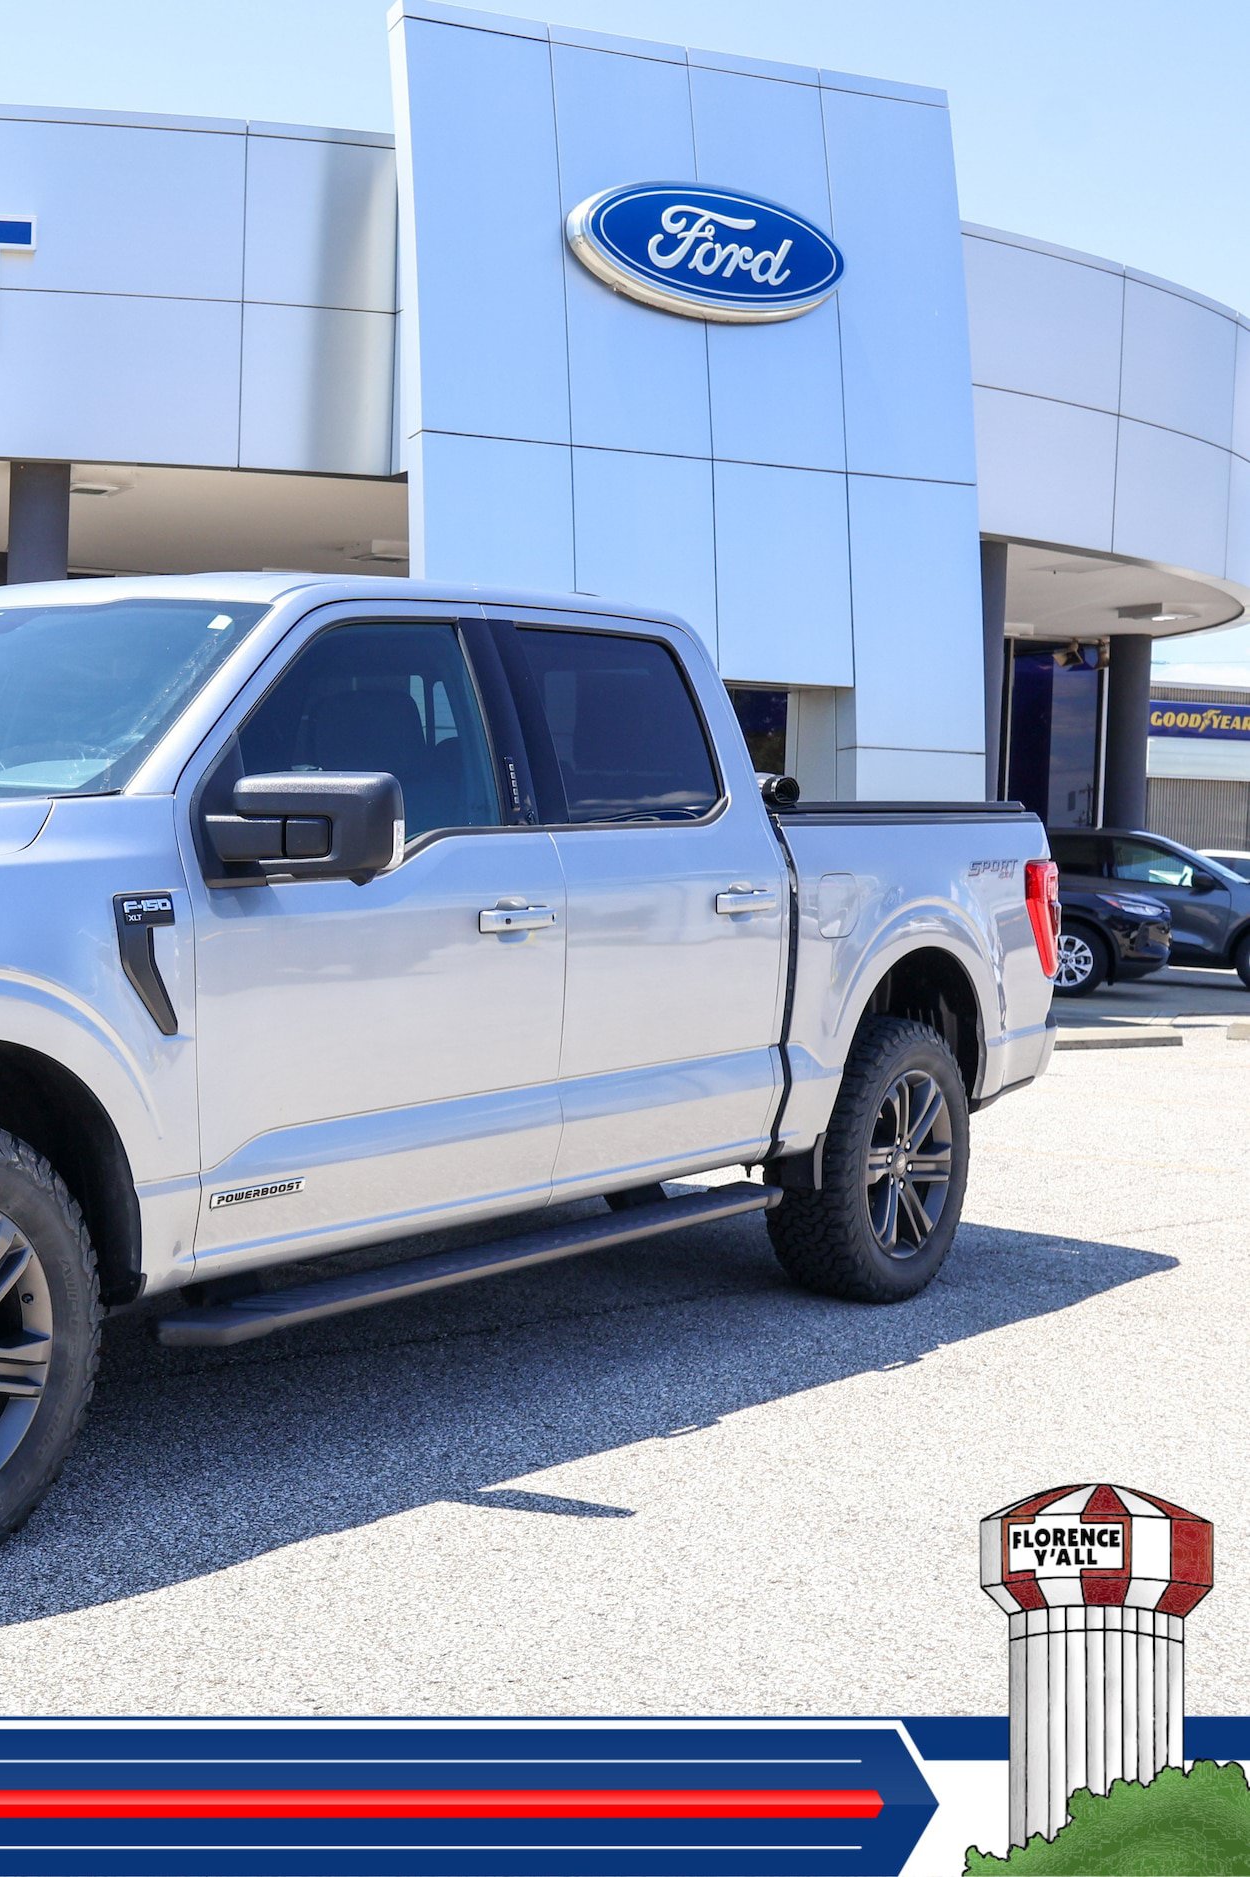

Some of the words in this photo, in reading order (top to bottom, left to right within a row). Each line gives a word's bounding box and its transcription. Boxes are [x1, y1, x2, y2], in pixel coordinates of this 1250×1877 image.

[648, 205, 793, 286] Ford
[1150, 710, 1250, 731] GOODYEAR
[968, 859, 1019, 877] SPORT
[123, 898, 172, 913] F-150
[128, 914, 142, 922] XLT
[217, 1181, 302, 1205] POWERBOOST
